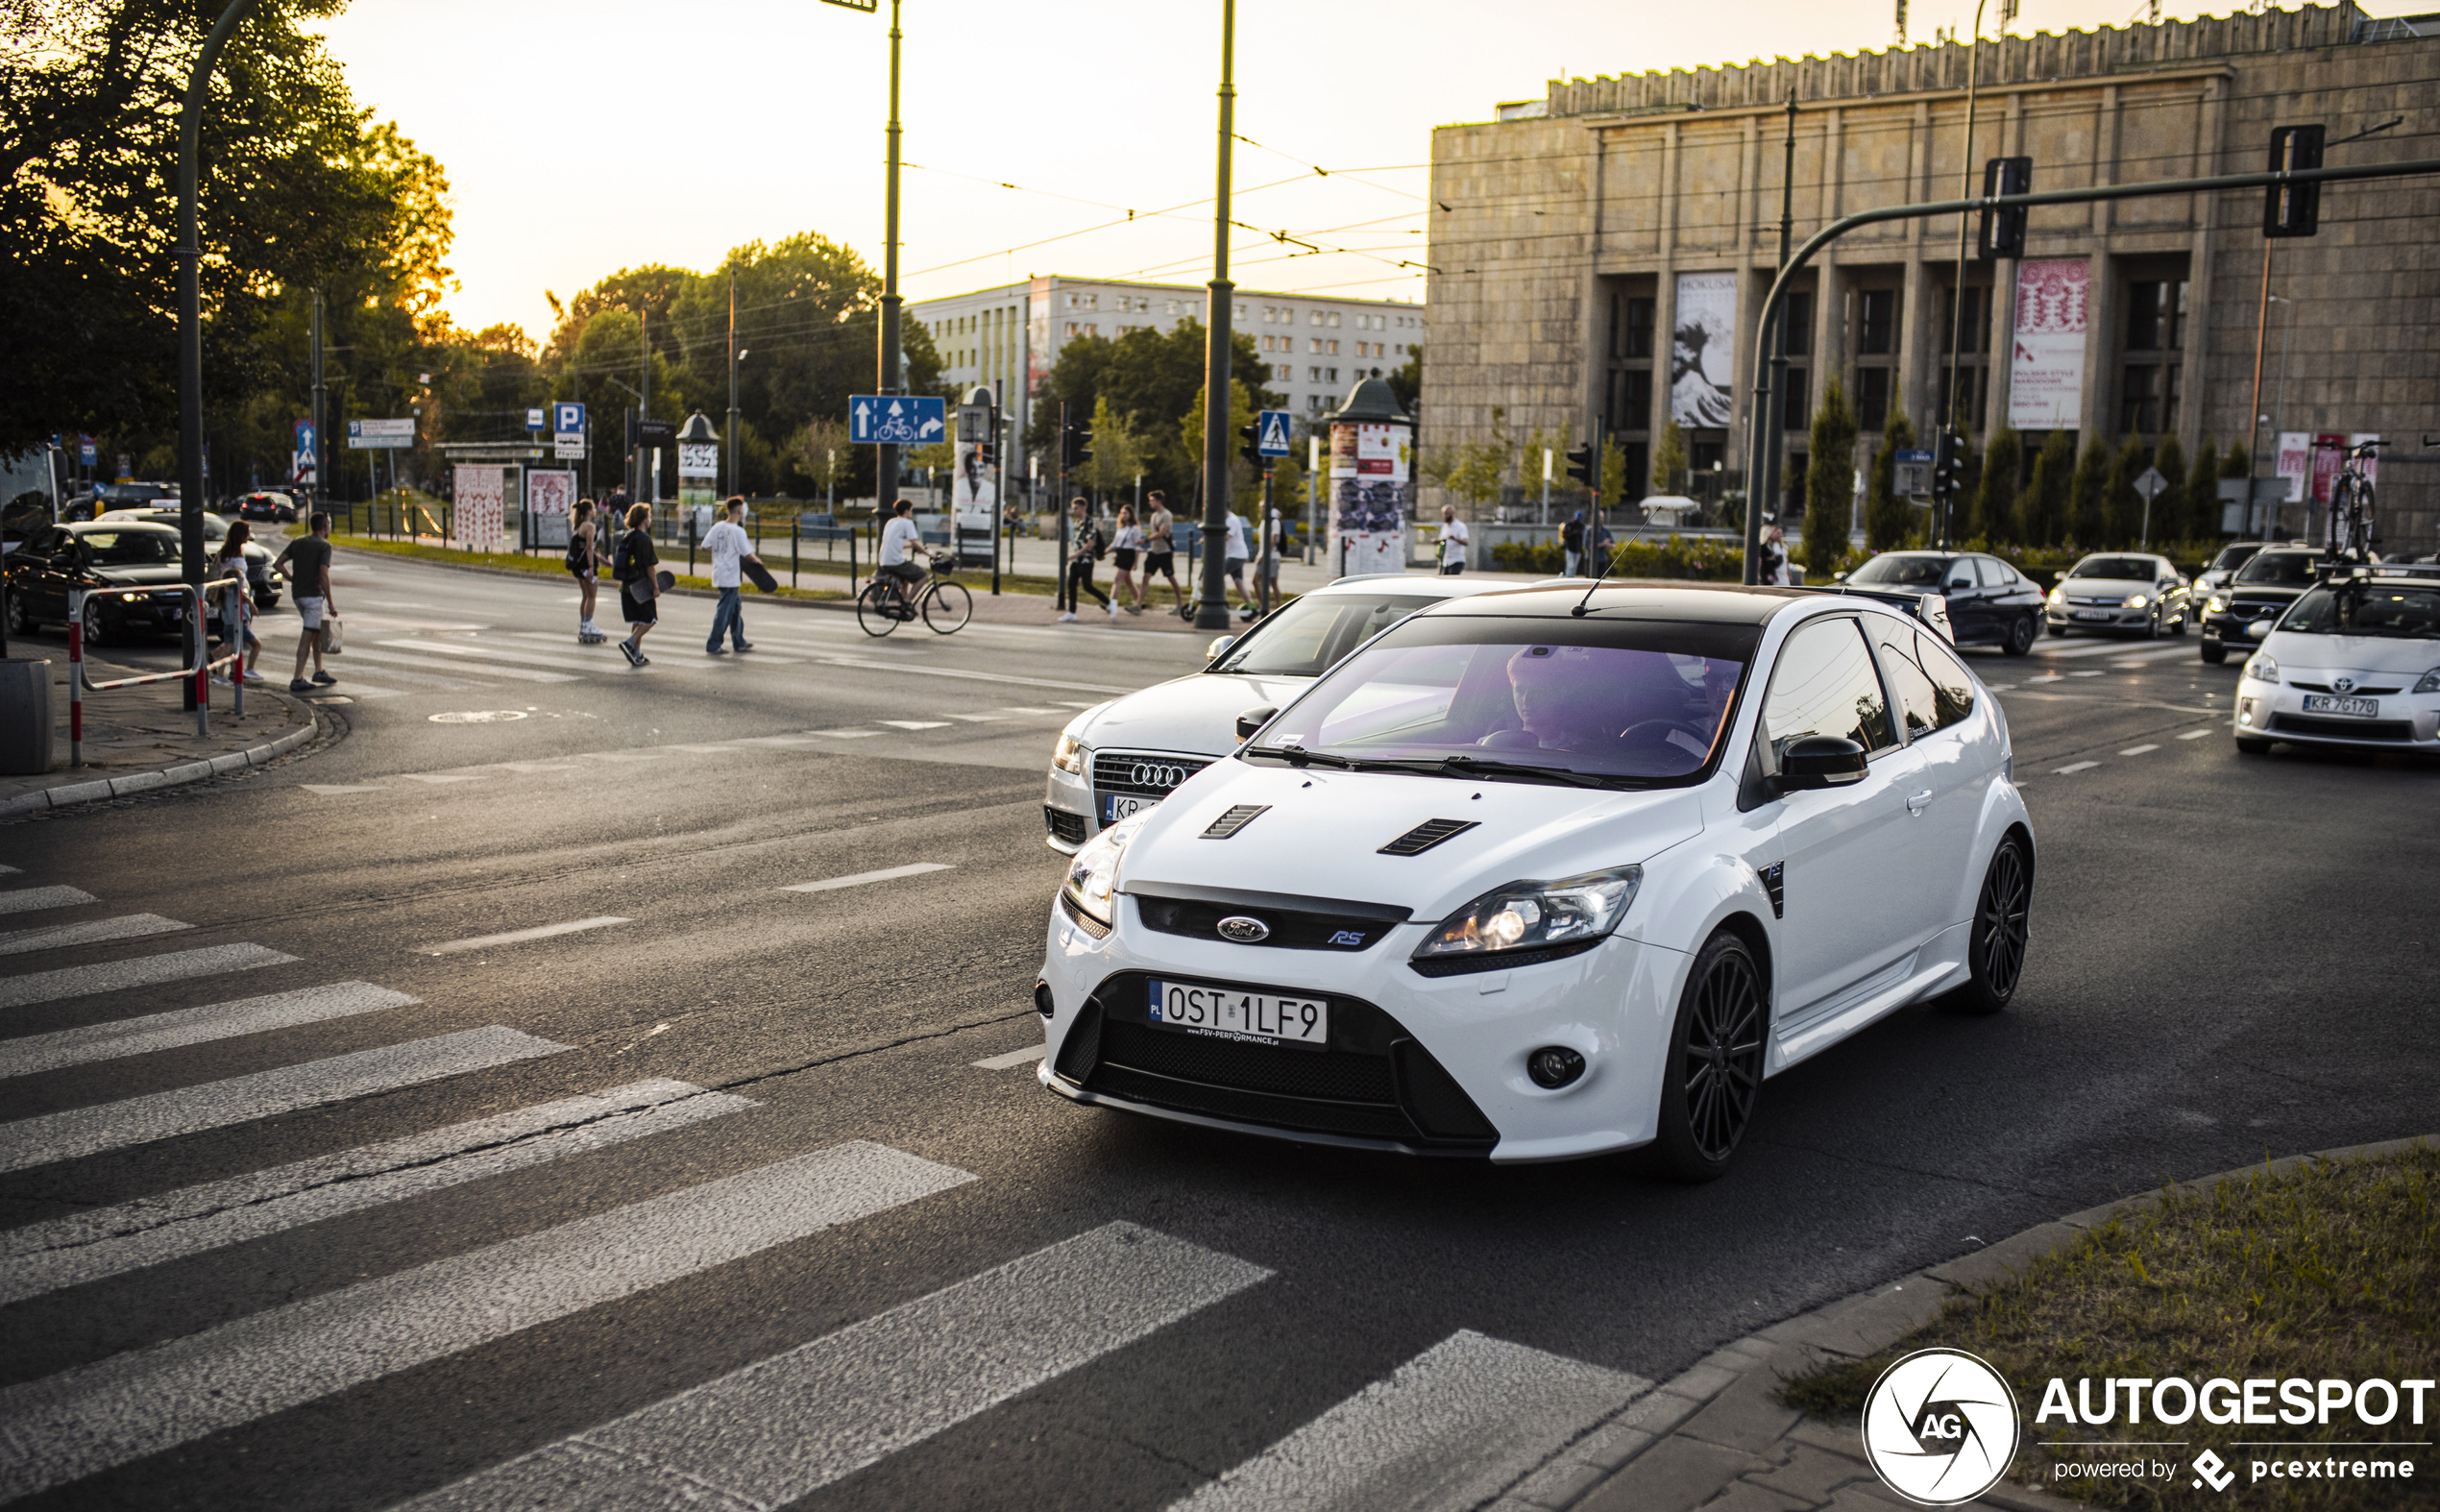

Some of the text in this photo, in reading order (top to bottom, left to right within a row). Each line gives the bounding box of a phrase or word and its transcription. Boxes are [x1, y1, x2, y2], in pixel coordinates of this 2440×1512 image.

[2311, 696, 2375, 713] KR 7G170
[1227, 921, 1256, 938] Ford
[1328, 930, 1366, 945] RS
[1151, 1004, 1161, 1015] PL
[1168, 987, 1318, 1037] OST 1LF9
